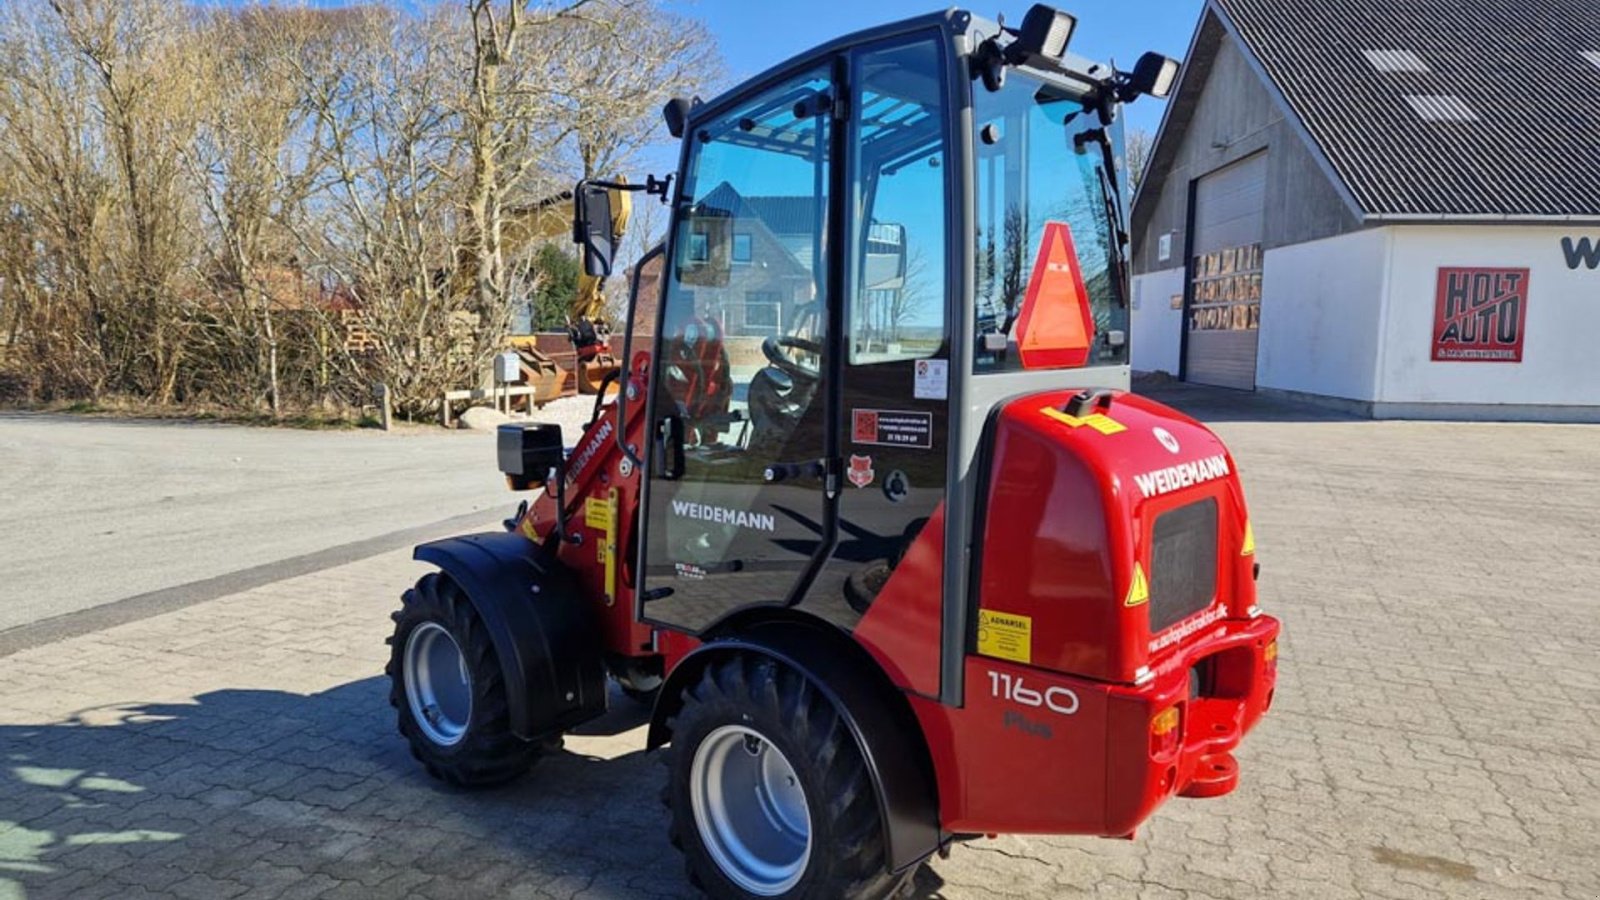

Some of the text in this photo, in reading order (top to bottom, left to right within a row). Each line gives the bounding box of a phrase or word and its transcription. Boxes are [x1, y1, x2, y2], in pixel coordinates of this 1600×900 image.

[1444, 271, 1522, 322] HOLT
[1439, 294, 1520, 345] AUTO
[1133, 454, 1230, 498] WEIDEMANN
[672, 499, 774, 532] WEIDEMANN
[987, 670, 1079, 715] 1160
[1004, 710, 1053, 739] Plus
